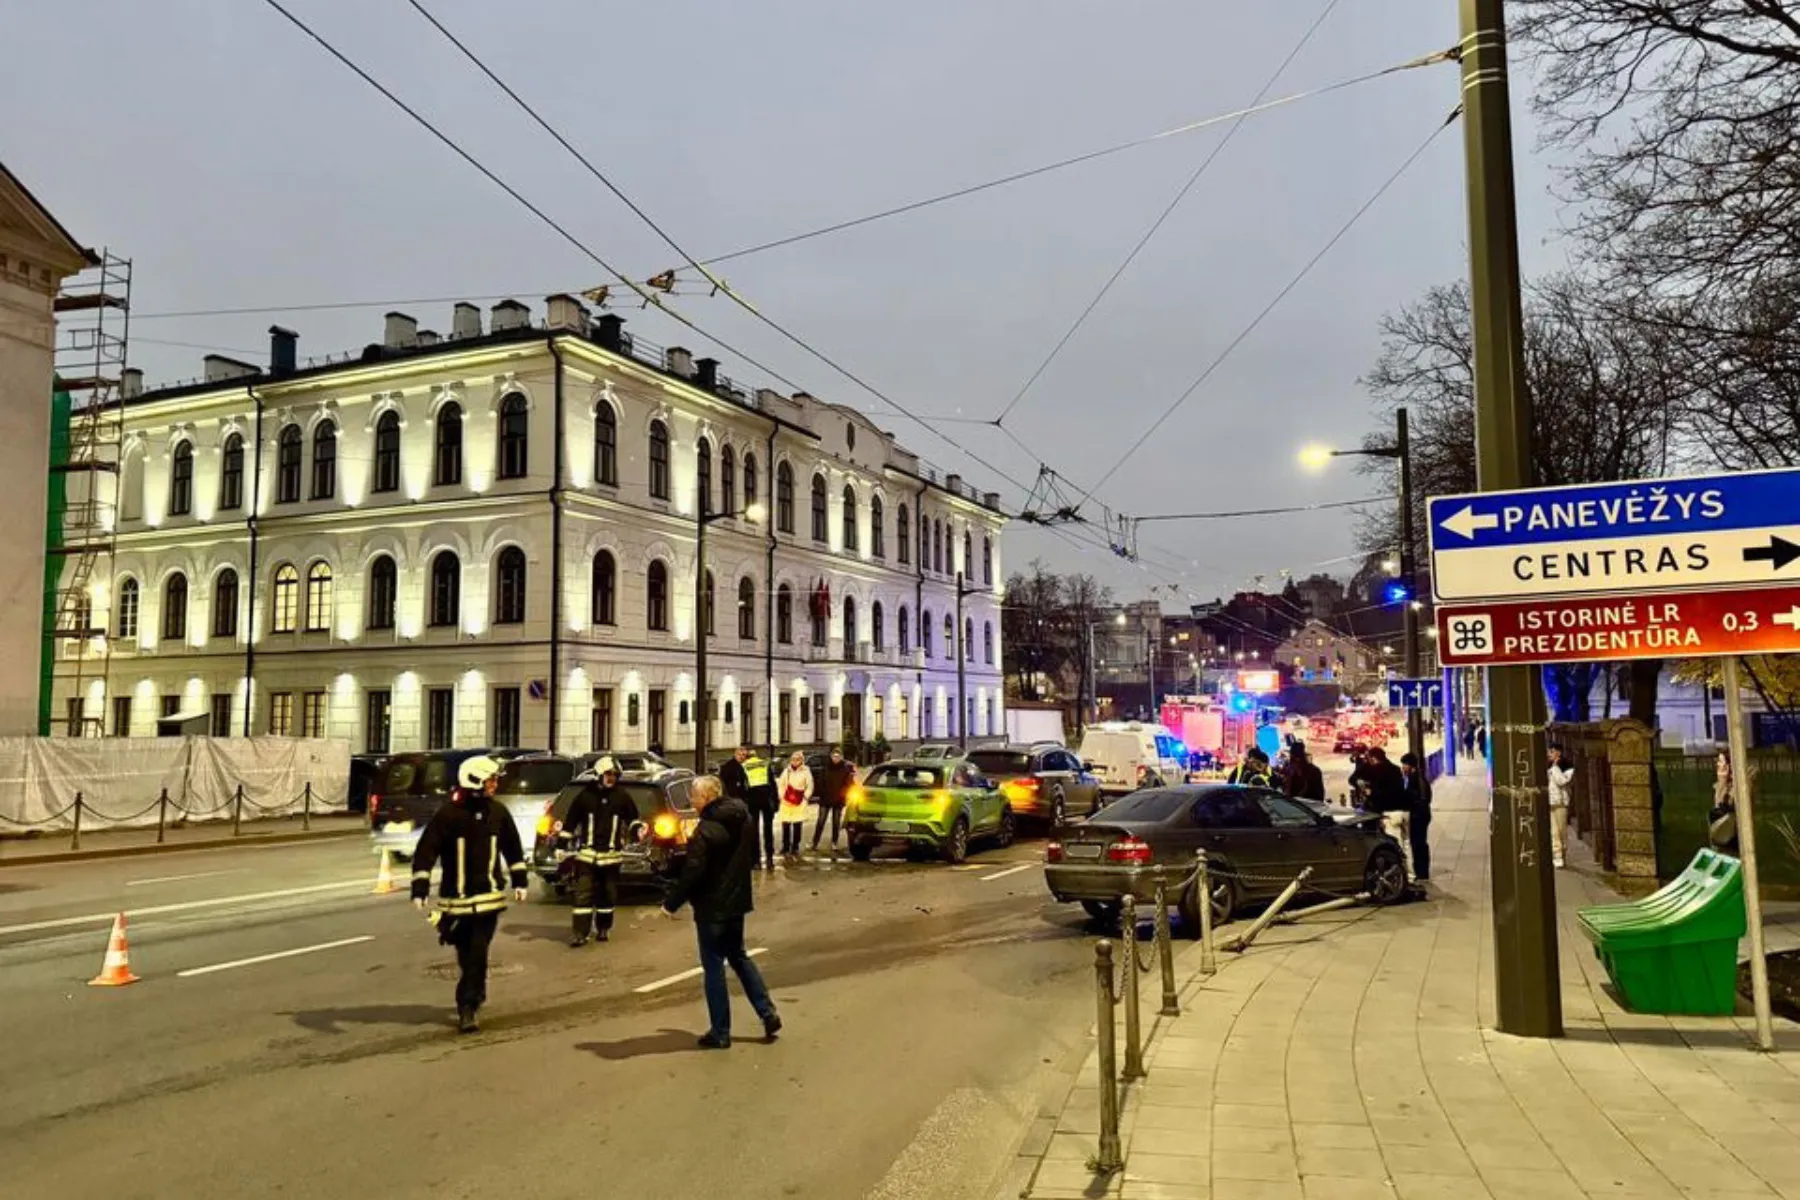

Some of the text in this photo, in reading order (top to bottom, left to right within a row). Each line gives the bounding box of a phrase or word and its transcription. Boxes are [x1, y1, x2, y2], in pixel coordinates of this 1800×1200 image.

[1503, 486, 1724, 532] PANEVĖŽYS
[1513, 543, 1710, 581] CENTRAS
[1519, 601, 1681, 630] ISTORINĖ LR
[1722, 611, 1759, 634] 0,3
[1504, 626, 1701, 654] PREZIDENTŪRA
